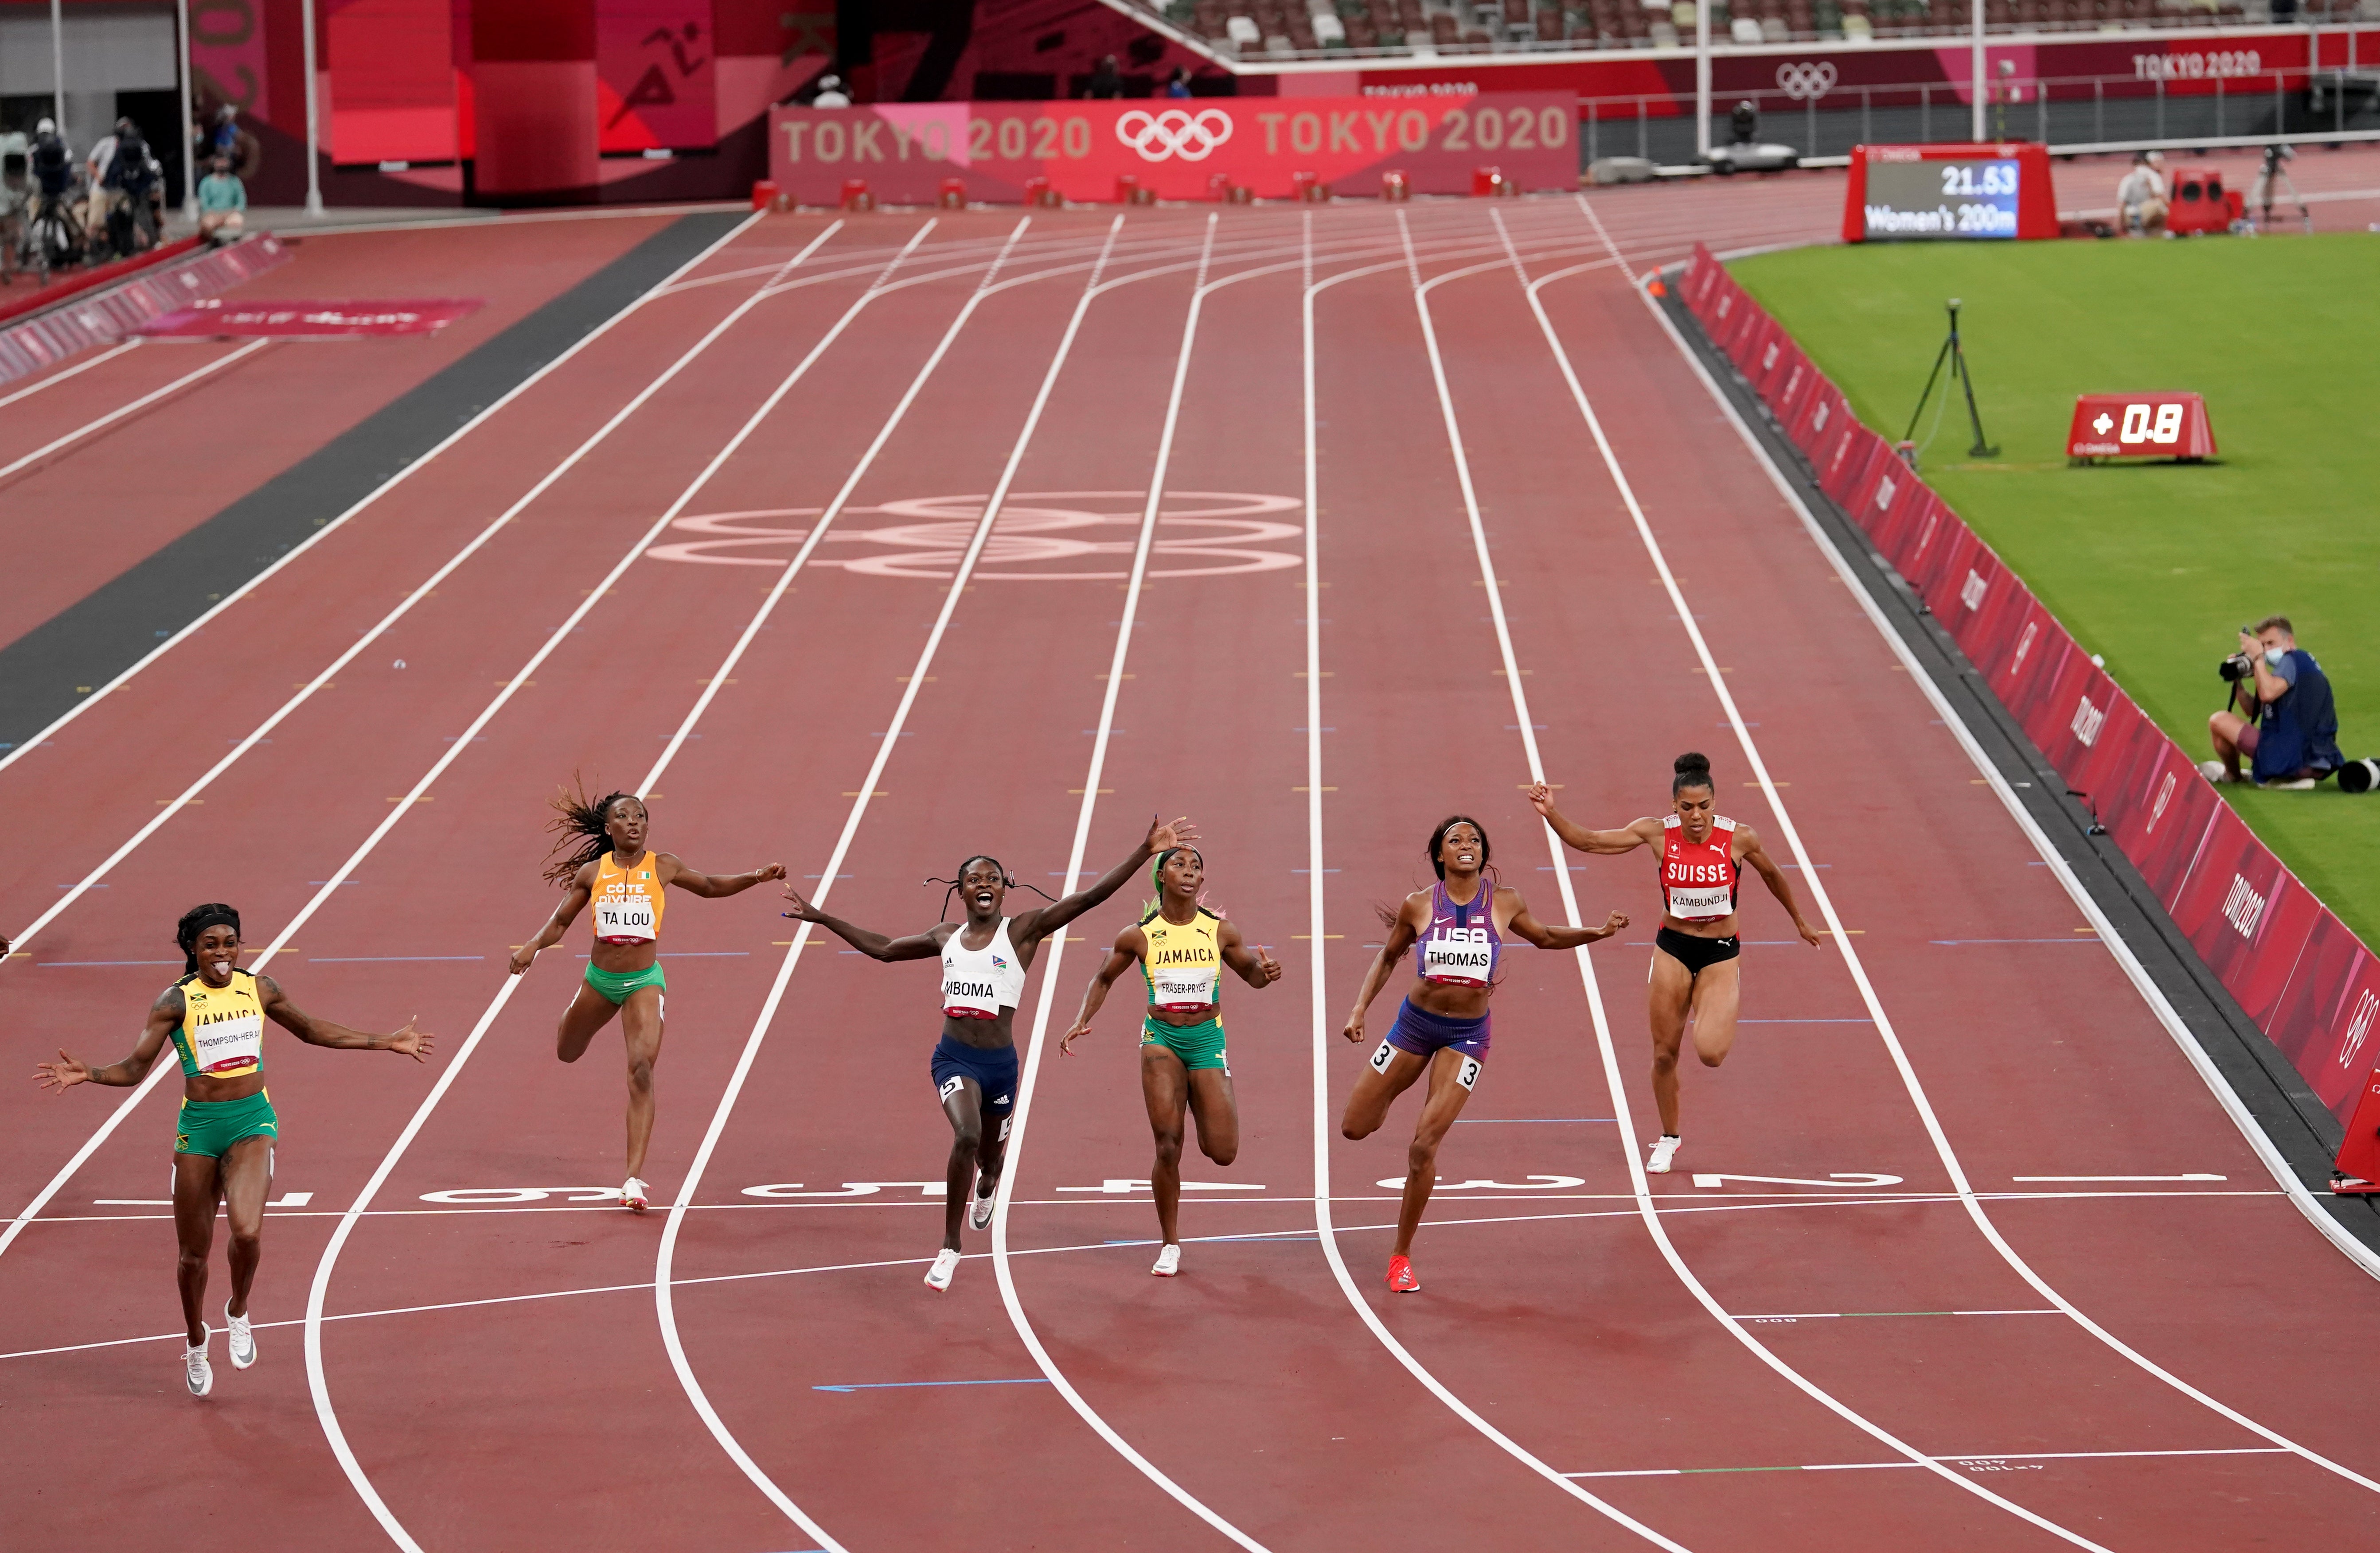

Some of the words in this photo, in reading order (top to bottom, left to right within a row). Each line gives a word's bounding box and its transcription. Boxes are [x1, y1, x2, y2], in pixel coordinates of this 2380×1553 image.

[2132, 52, 2204, 80] TOKYO
[2205, 50, 2260, 77] 2020
[780, 120, 951, 163] TOKYO
[969, 117, 1092, 160] 2020
[1256, 109, 1428, 154] TOKYO
[1442, 106, 1567, 151] 2020
[1941, 165, 2017, 195] 21.53
[1865, 204, 1955, 232] Women's
[1957, 203, 2016, 231] 200m
[2120, 404, 2183, 444] 0.8
[1668, 862, 1727, 882] SUISSE
[606, 882, 645, 893] CÔTE
[1673, 893, 1728, 907] KAMBUNDJI
[603, 912, 618, 925] TA
[624, 913, 649, 926] LOU
[1433, 927, 1488, 943] USA
[1155, 948, 1214, 965] JAMAICA
[1429, 951, 1488, 966] THOMAS
[944, 981, 993, 998] MBOMA
[1162, 982, 1206, 994] FRASER-PRYCE
[1374, 1045, 1390, 1066] 3
[1464, 1063, 1477, 1086] 3
[942, 1078, 956, 1095] 5
[93, 1192, 313, 1206] 7
[419, 1187, 621, 1203] 6
[741, 1182, 947, 1196] 5
[1056, 1179, 1266, 1193] 4
[1376, 1175, 1585, 1189] 3
[1693, 1173, 1903, 1187] 2
